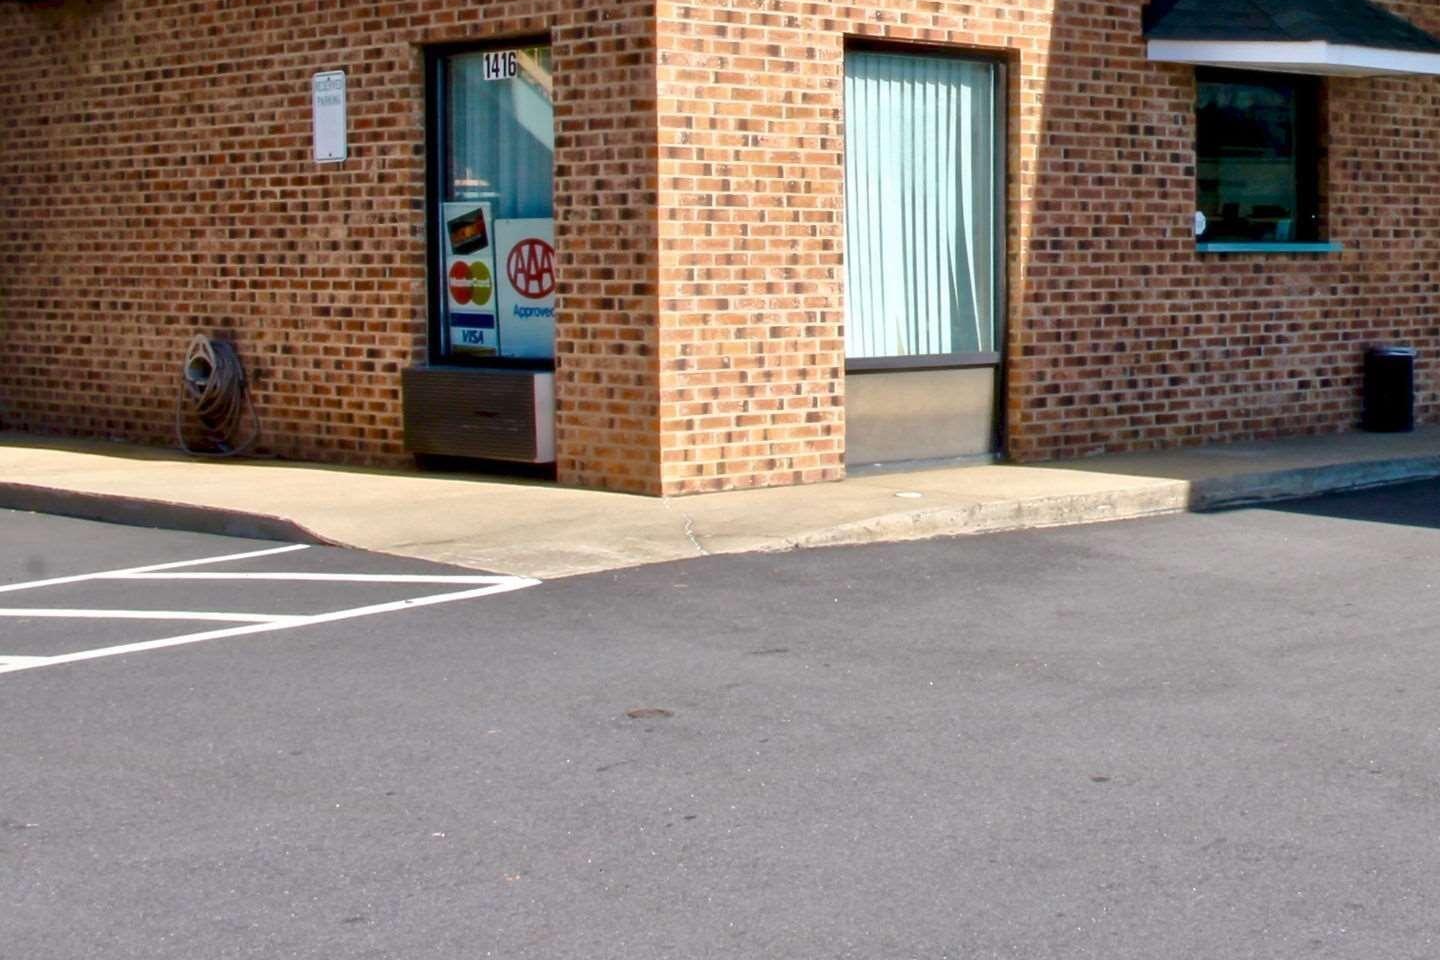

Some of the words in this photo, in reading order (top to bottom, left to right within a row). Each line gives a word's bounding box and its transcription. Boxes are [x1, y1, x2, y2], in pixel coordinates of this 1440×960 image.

[485, 51, 517, 79] 1416
[513, 240, 556, 296] AAA
[461, 329, 485, 344] VISA
